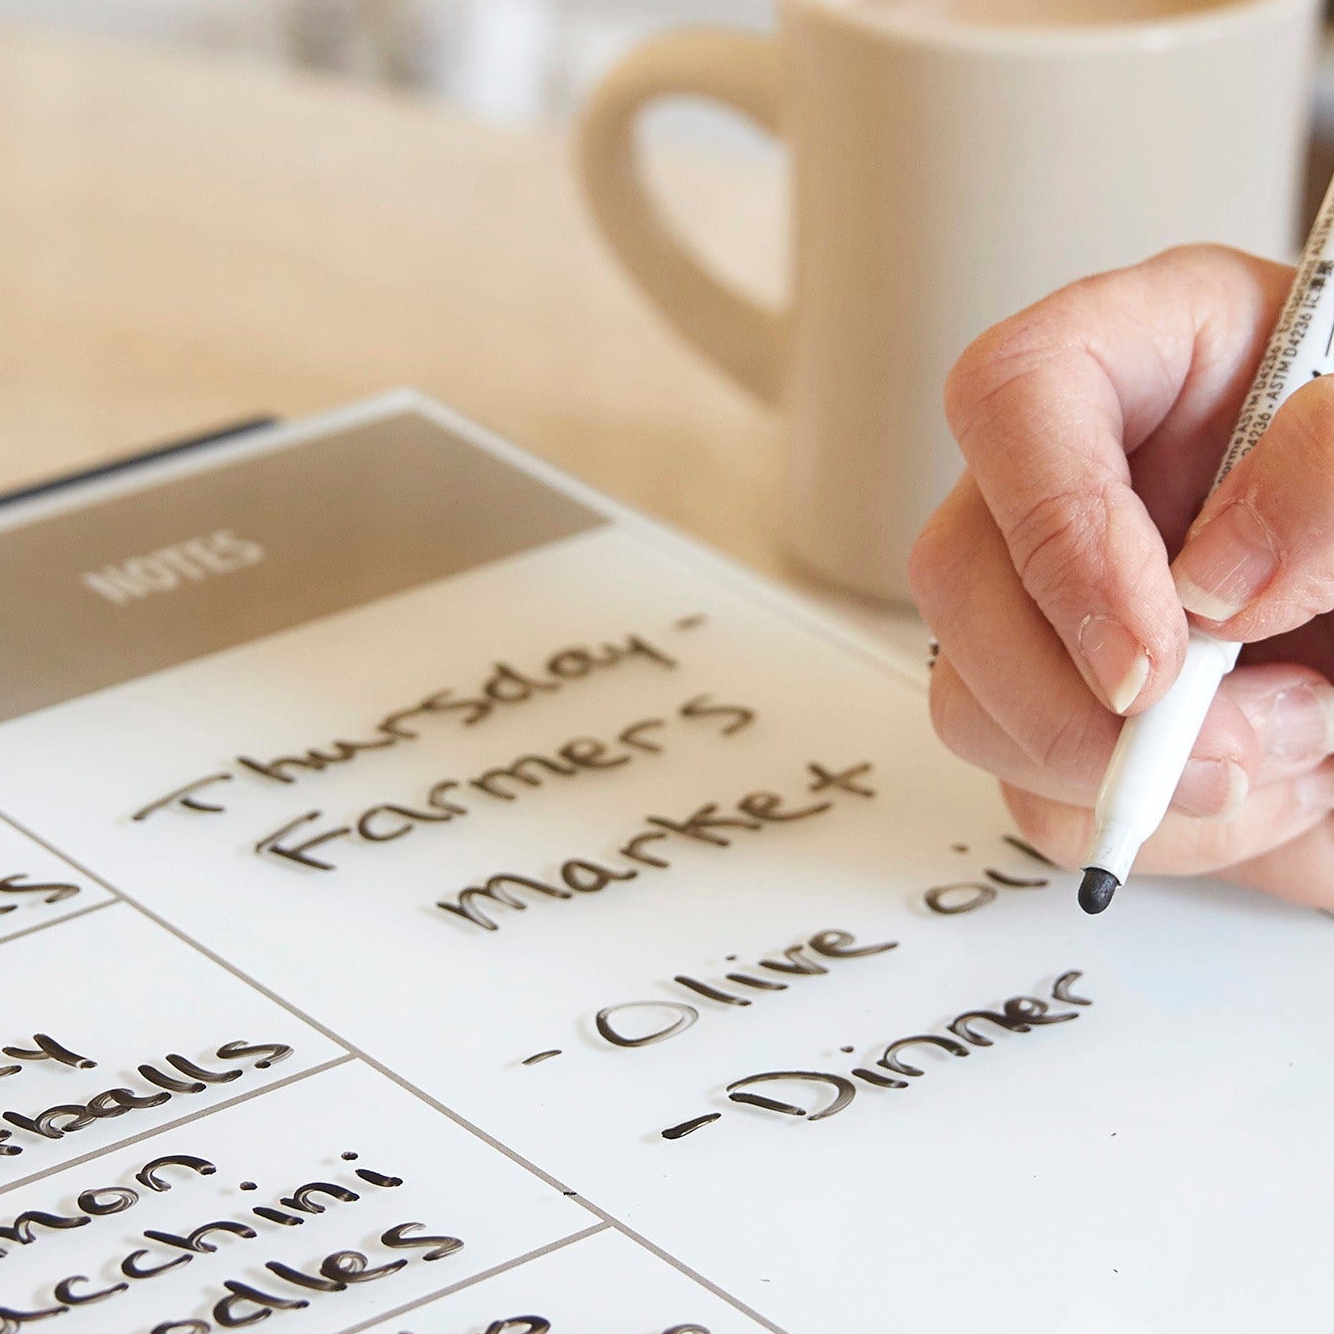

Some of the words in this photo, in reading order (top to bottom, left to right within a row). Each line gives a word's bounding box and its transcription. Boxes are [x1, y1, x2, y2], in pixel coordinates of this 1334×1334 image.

[1267, 361, 1291, 399] ASTM
[1284, 313, 1312, 357] D4236
[83, 528, 265, 605] NOTES
[256, 691, 756, 870] Farmers
[925, 834, 1063, 914] oil
